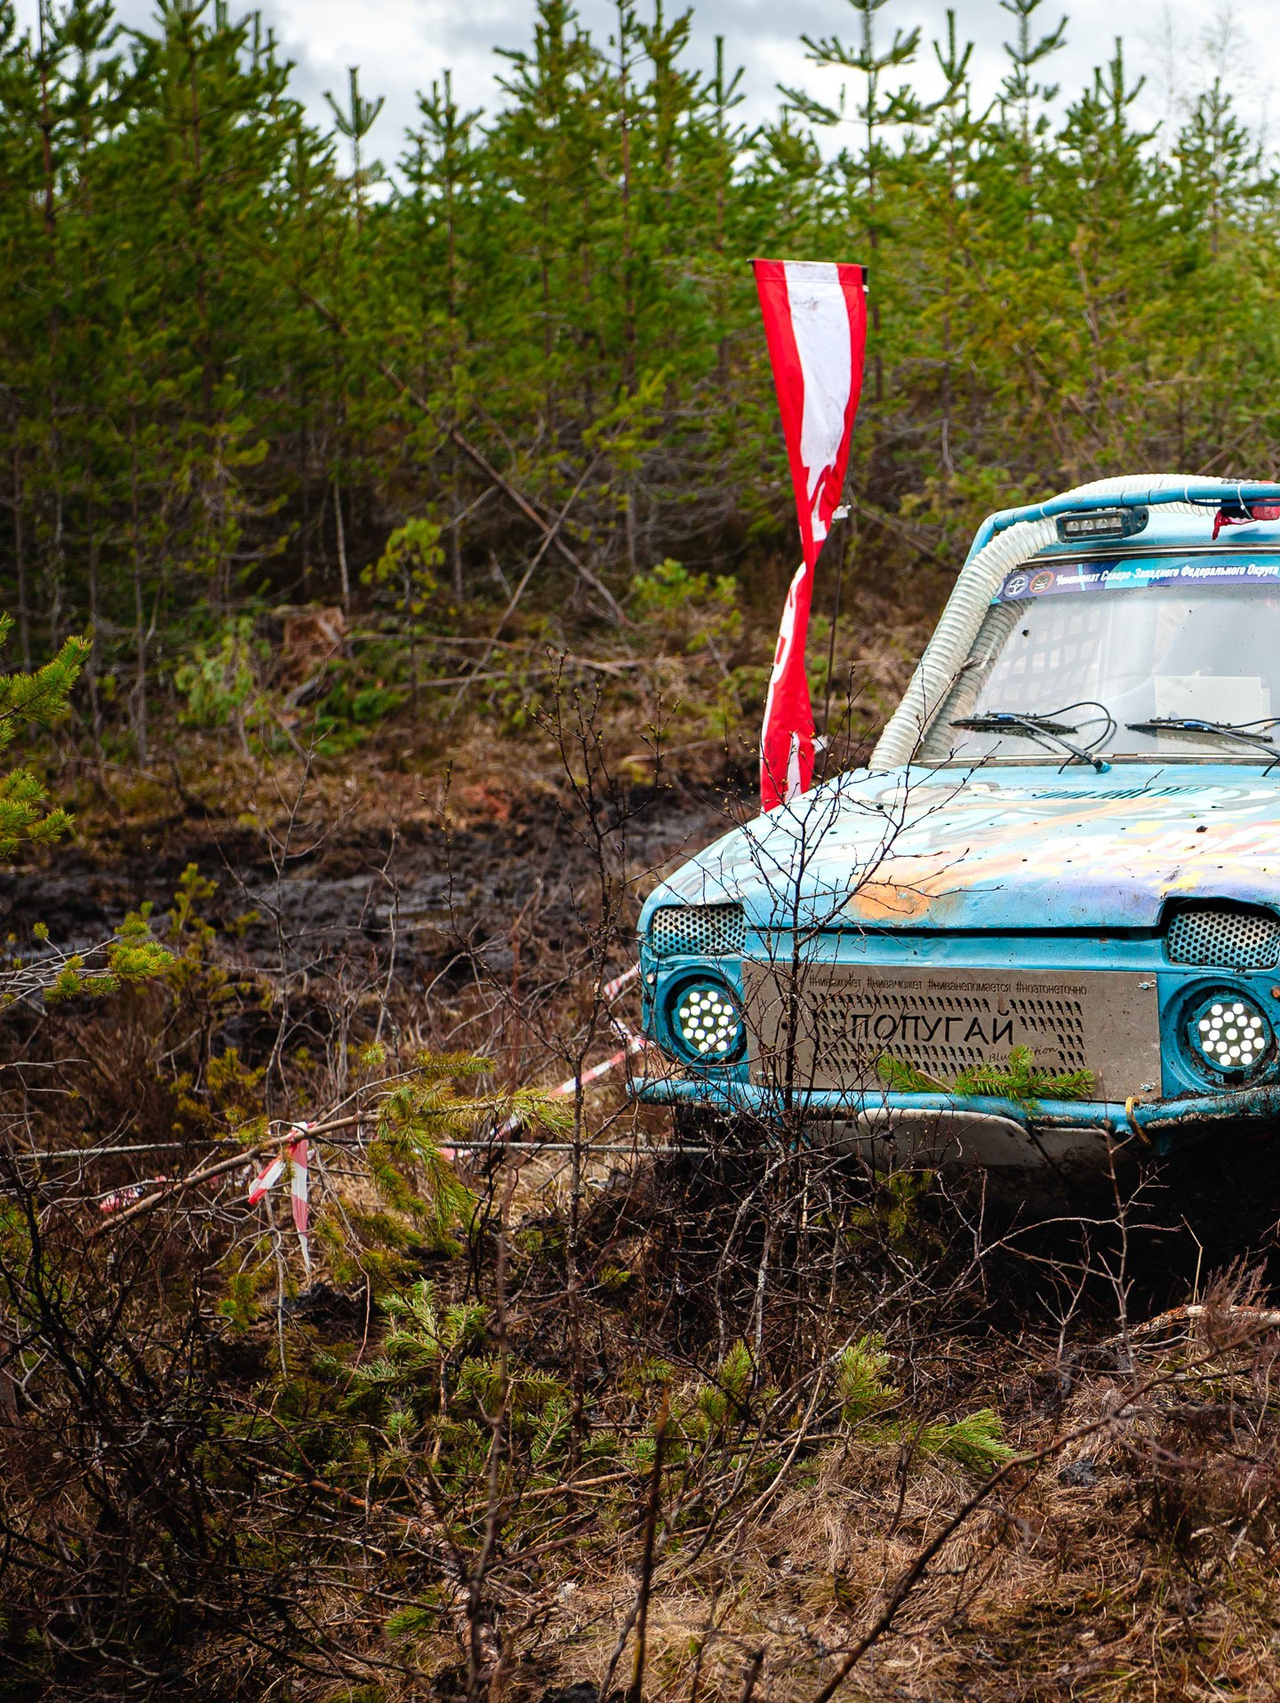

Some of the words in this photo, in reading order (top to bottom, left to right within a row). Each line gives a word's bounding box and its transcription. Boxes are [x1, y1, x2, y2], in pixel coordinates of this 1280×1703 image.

[1101, 567, 1179, 581] Северо-Западного
[1181, 565, 1246, 578] Федерального
[1247, 563, 1279, 577] Округа
[1016, 981, 1087, 995] #ноэтонеточно
[851, 1009, 1013, 1046] ПОПУГАЙ
